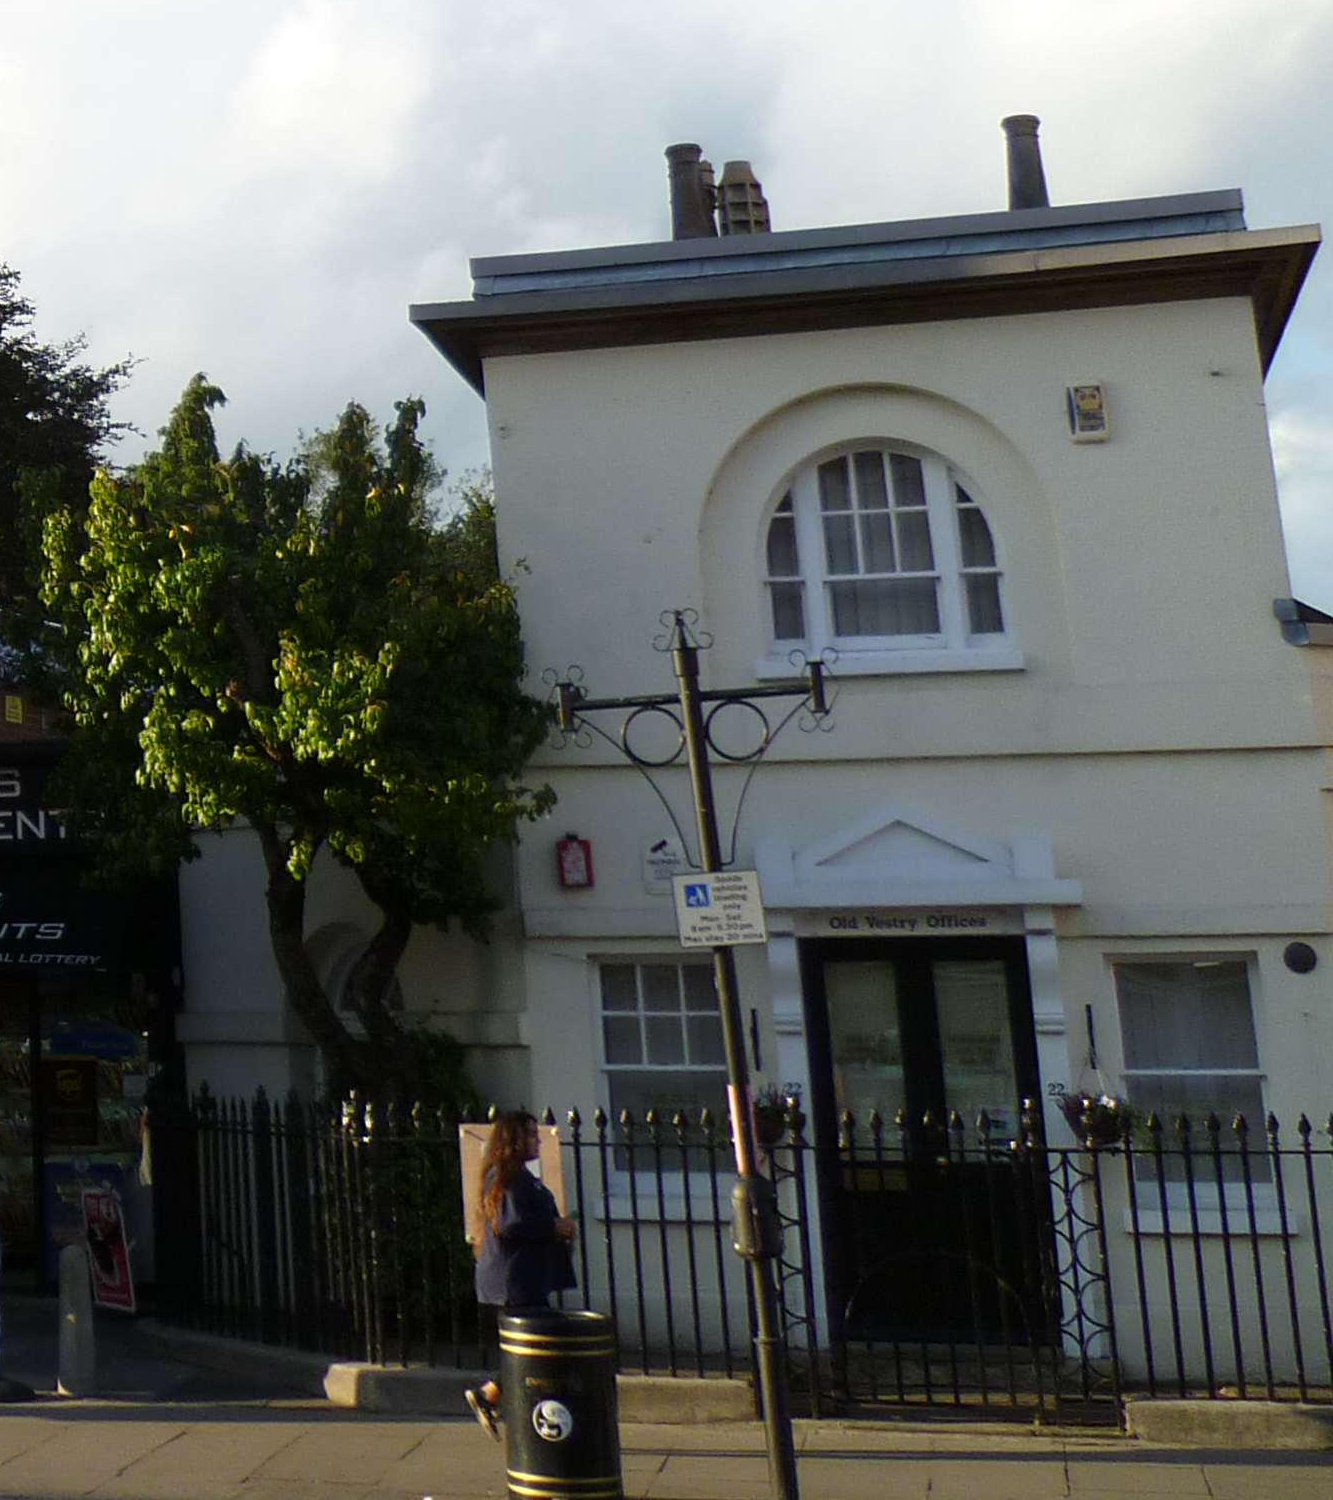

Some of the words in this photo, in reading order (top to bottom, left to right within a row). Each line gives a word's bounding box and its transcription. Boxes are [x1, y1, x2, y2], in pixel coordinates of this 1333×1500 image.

[829, 916, 858, 930] Old
[865, 915, 918, 932] Vestry
[925, 914, 988, 929] Offices
[18, 952, 102, 966] LOTTERY
[1047, 1082, 1066, 1096] 22
